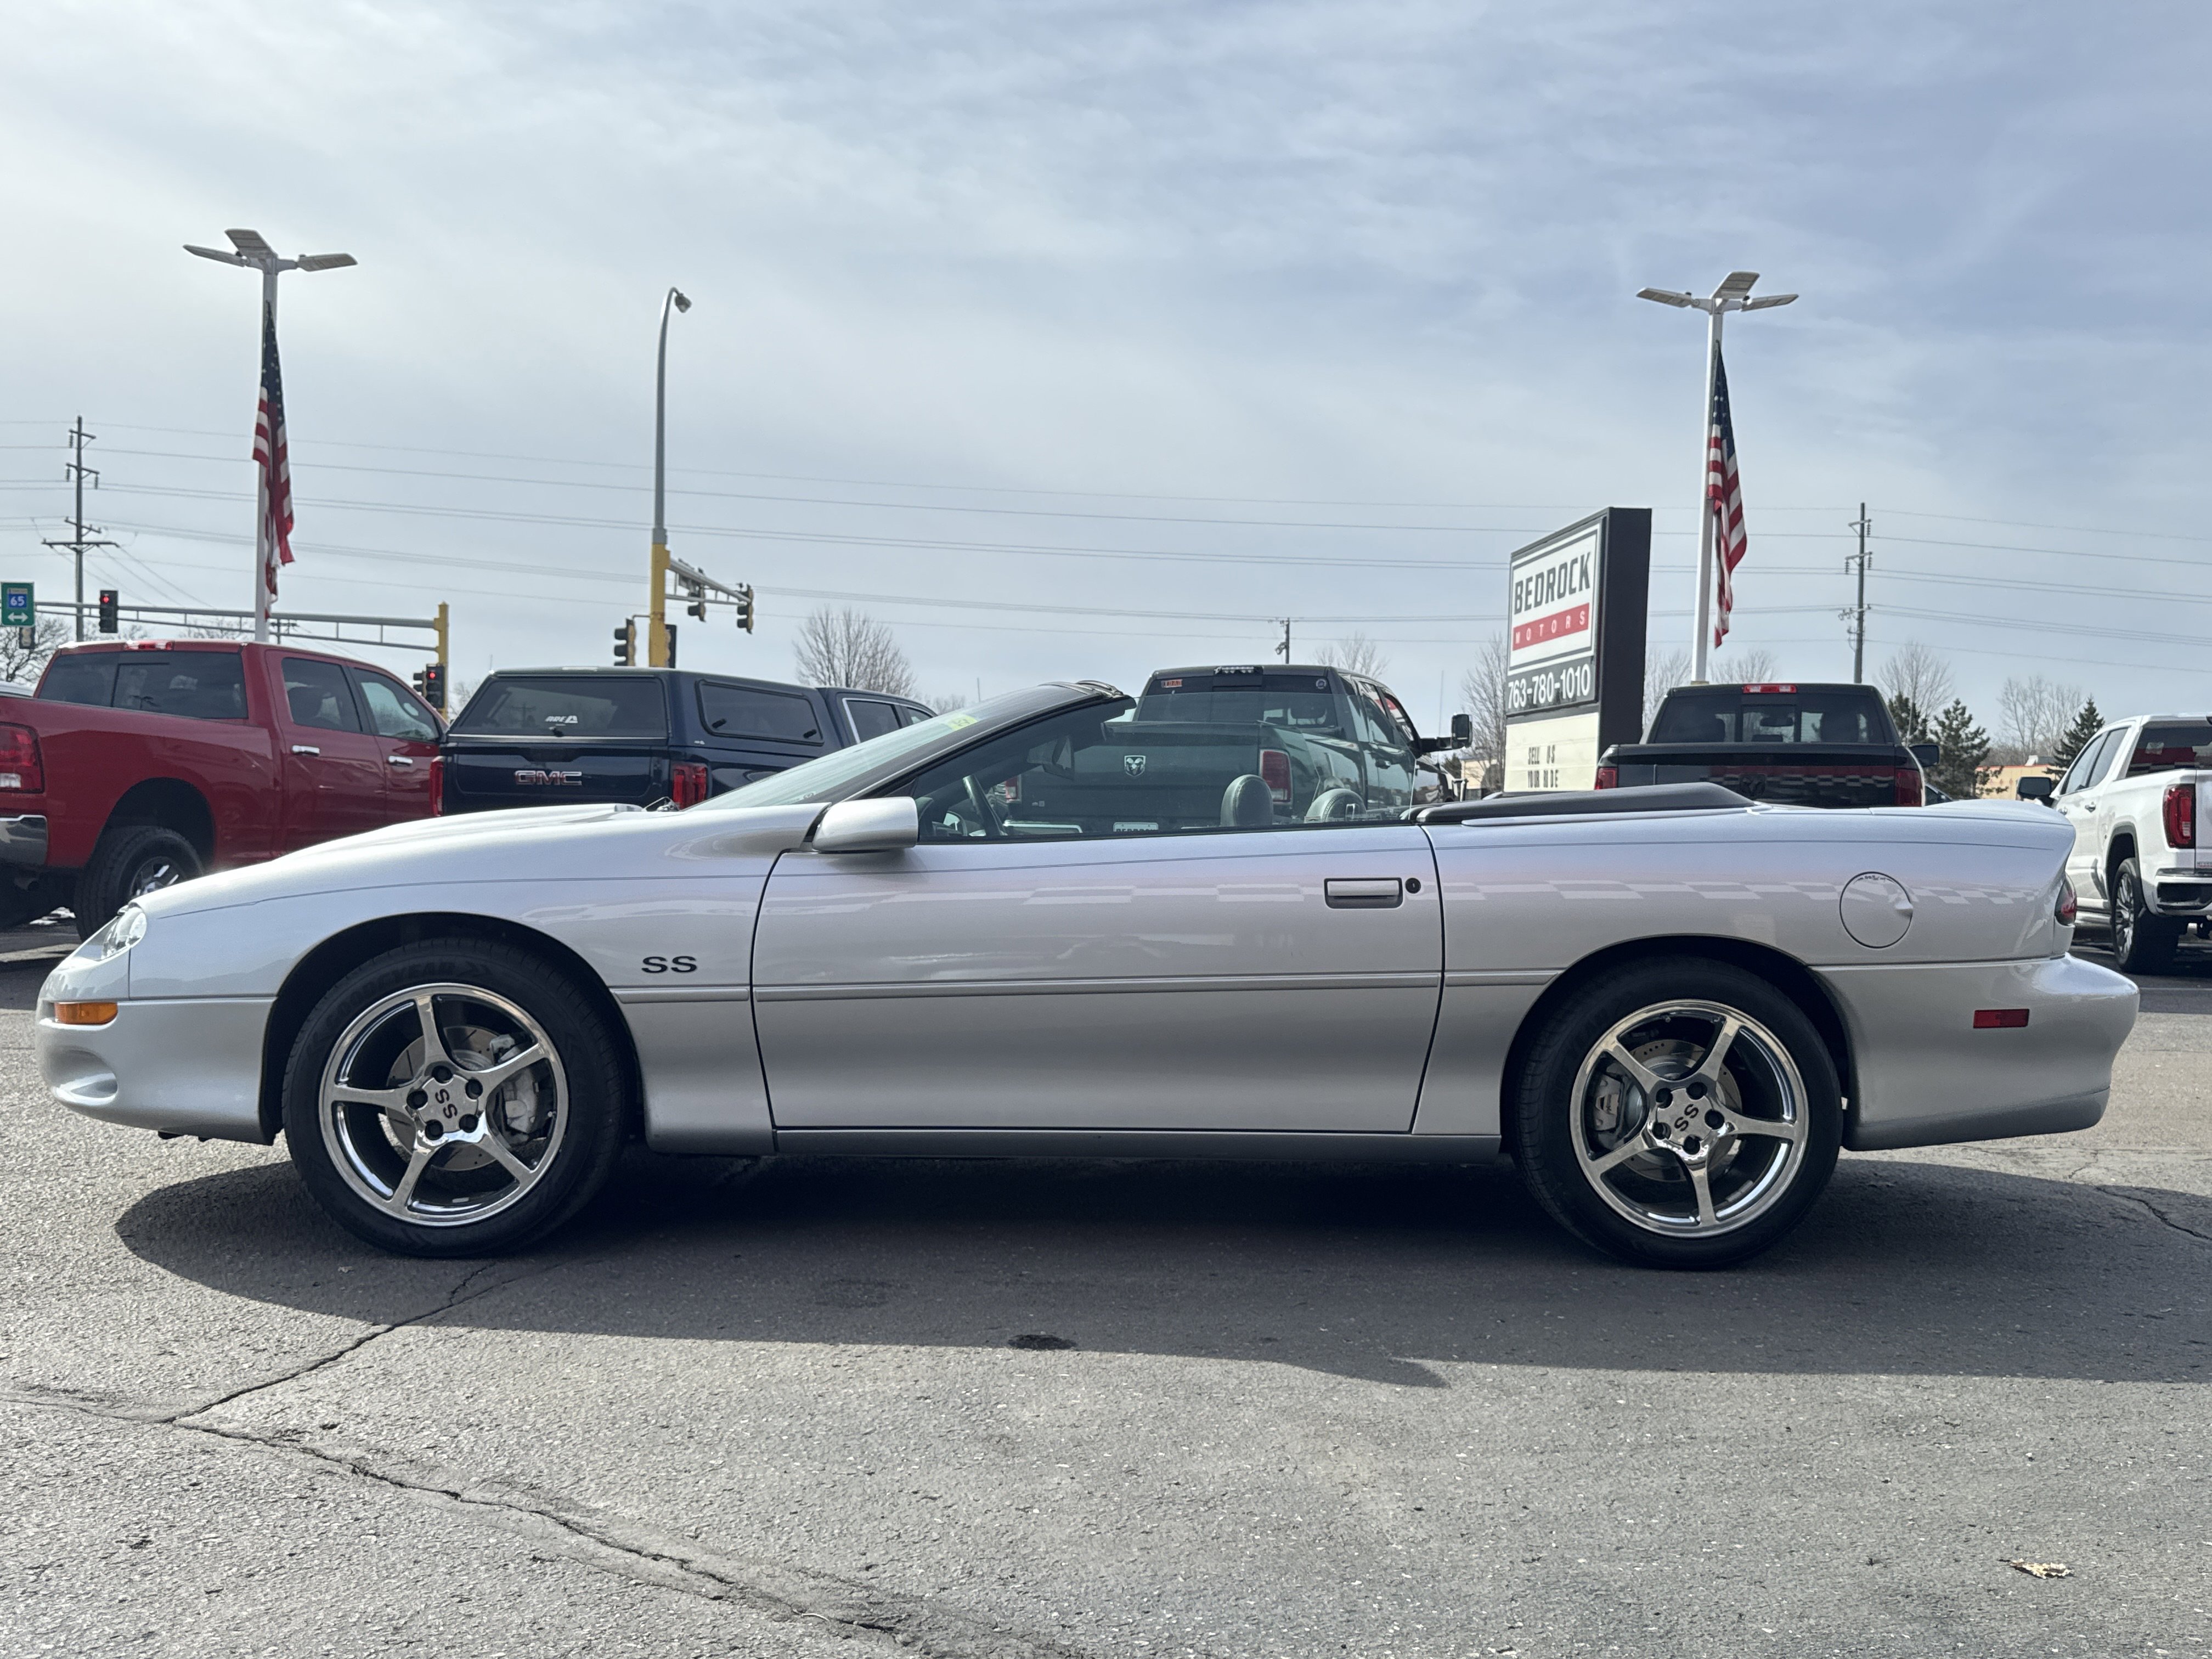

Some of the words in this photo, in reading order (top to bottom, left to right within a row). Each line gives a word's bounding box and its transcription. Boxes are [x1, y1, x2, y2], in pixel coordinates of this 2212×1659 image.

[1514, 551, 1590, 615] BEDROCK
[10, 596, 25, 607] 65
[1515, 610, 1586, 644] MOTORS
[1508, 663, 1591, 709] 763-780-1010
[515, 770, 583, 786] GMC
[641, 956, 697, 973] SS
[435, 1088, 458, 1119] SS
[1674, 1103, 1699, 1132] SS
